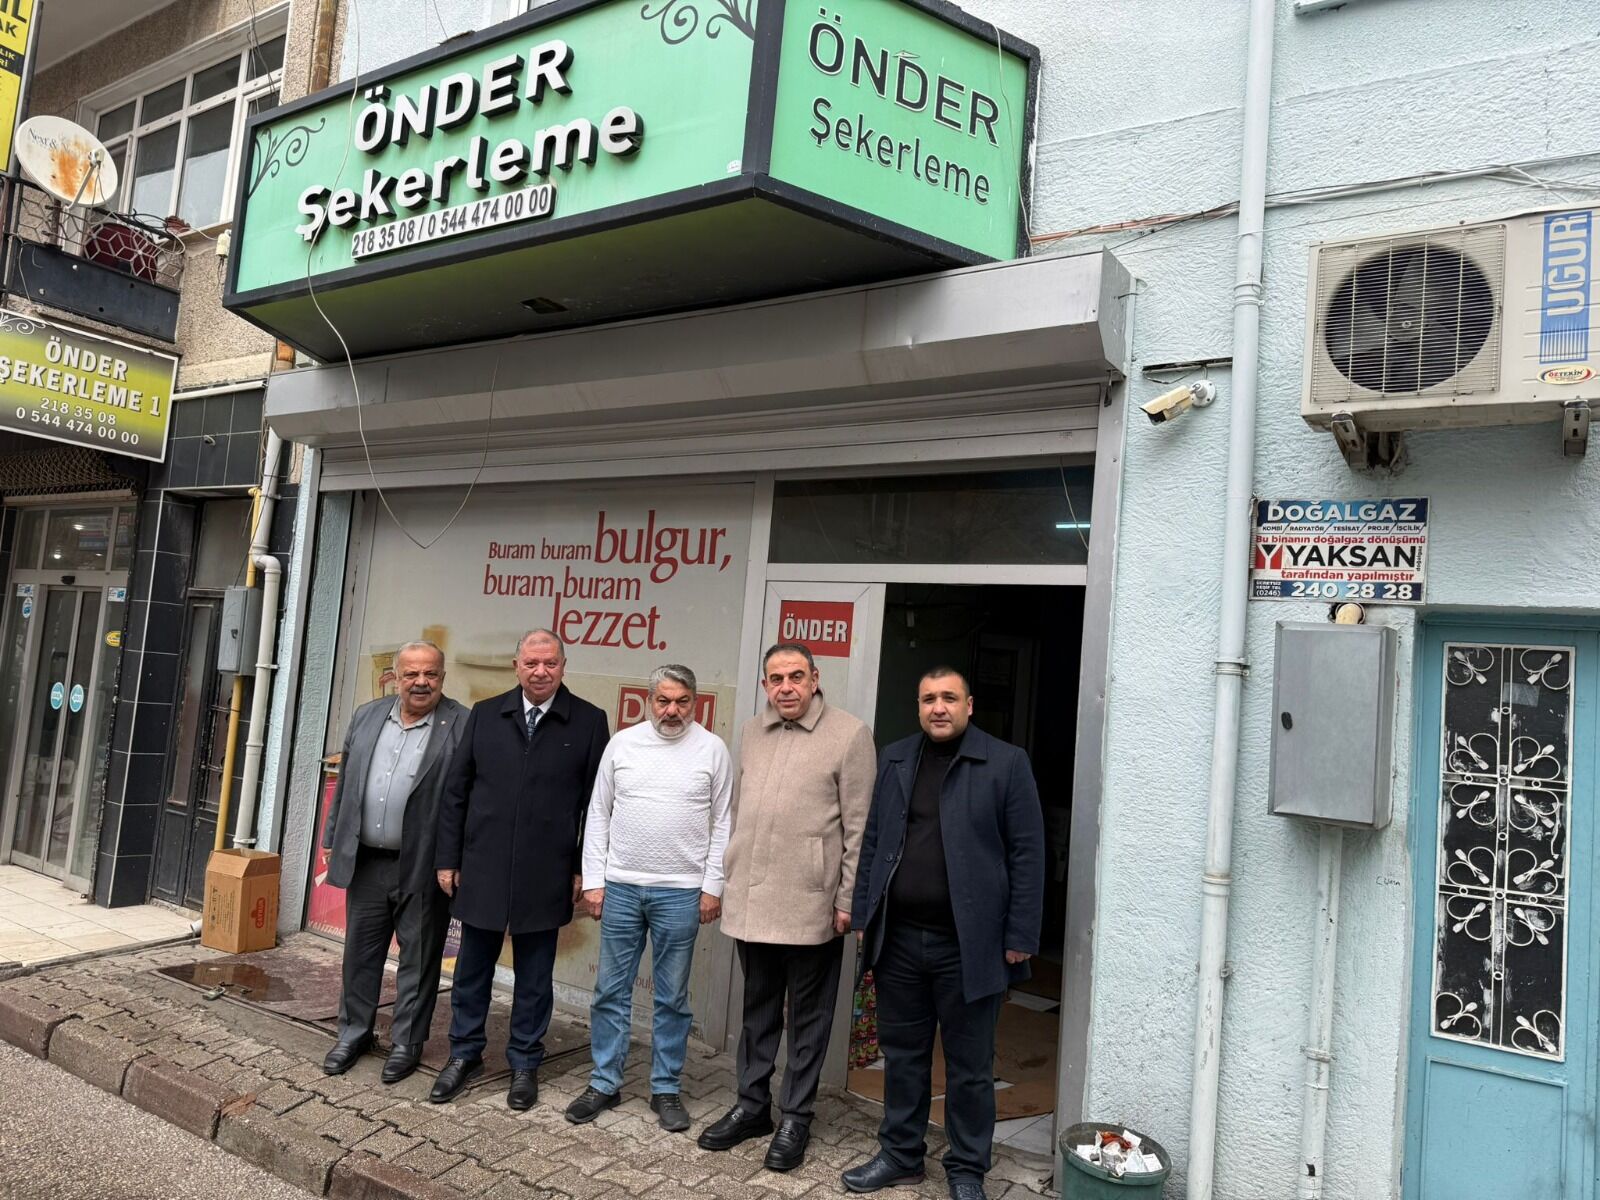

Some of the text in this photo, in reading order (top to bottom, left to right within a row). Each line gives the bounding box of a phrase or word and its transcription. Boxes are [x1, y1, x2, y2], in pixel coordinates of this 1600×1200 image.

[354, 39, 573, 154] ÖNDER
[808, 7, 999, 147] ÖNDER
[809, 97, 990, 204] Şekerleme
[295, 106, 644, 242] Şekerleme
[352, 231, 375, 256] 218
[379, 224, 395, 251] 35
[399, 219, 415, 245] 08
[427, 213, 436, 236] 0
[440, 206, 467, 233] 544
[471, 198, 499, 226] 474
[504, 192, 523, 219] 00
[529, 186, 549, 213] 00
[45, 335, 128, 382] ÖNDER
[0, 356, 161, 417] ŞEKERLEME 1
[16, 407, 139, 445] 0 544 474 00 00
[40, 397, 116, 426] 218 35 08
[1267, 500, 1417, 521] DOĞALGAZ
[488, 509, 732, 584] Buram buram bulgur,
[1256, 535, 1426, 545] Bu binanın doğalgaz dönüşümü
[1286, 545, 1416, 568] YAKSAN
[483, 564, 641, 600] buram buram
[1281, 569, 1414, 582] tarafından yapılmıştır
[1291, 581, 1413, 600] 240 28 28
[552, 591, 667, 651] lezzet.
[783, 612, 848, 642] ÖNDER
